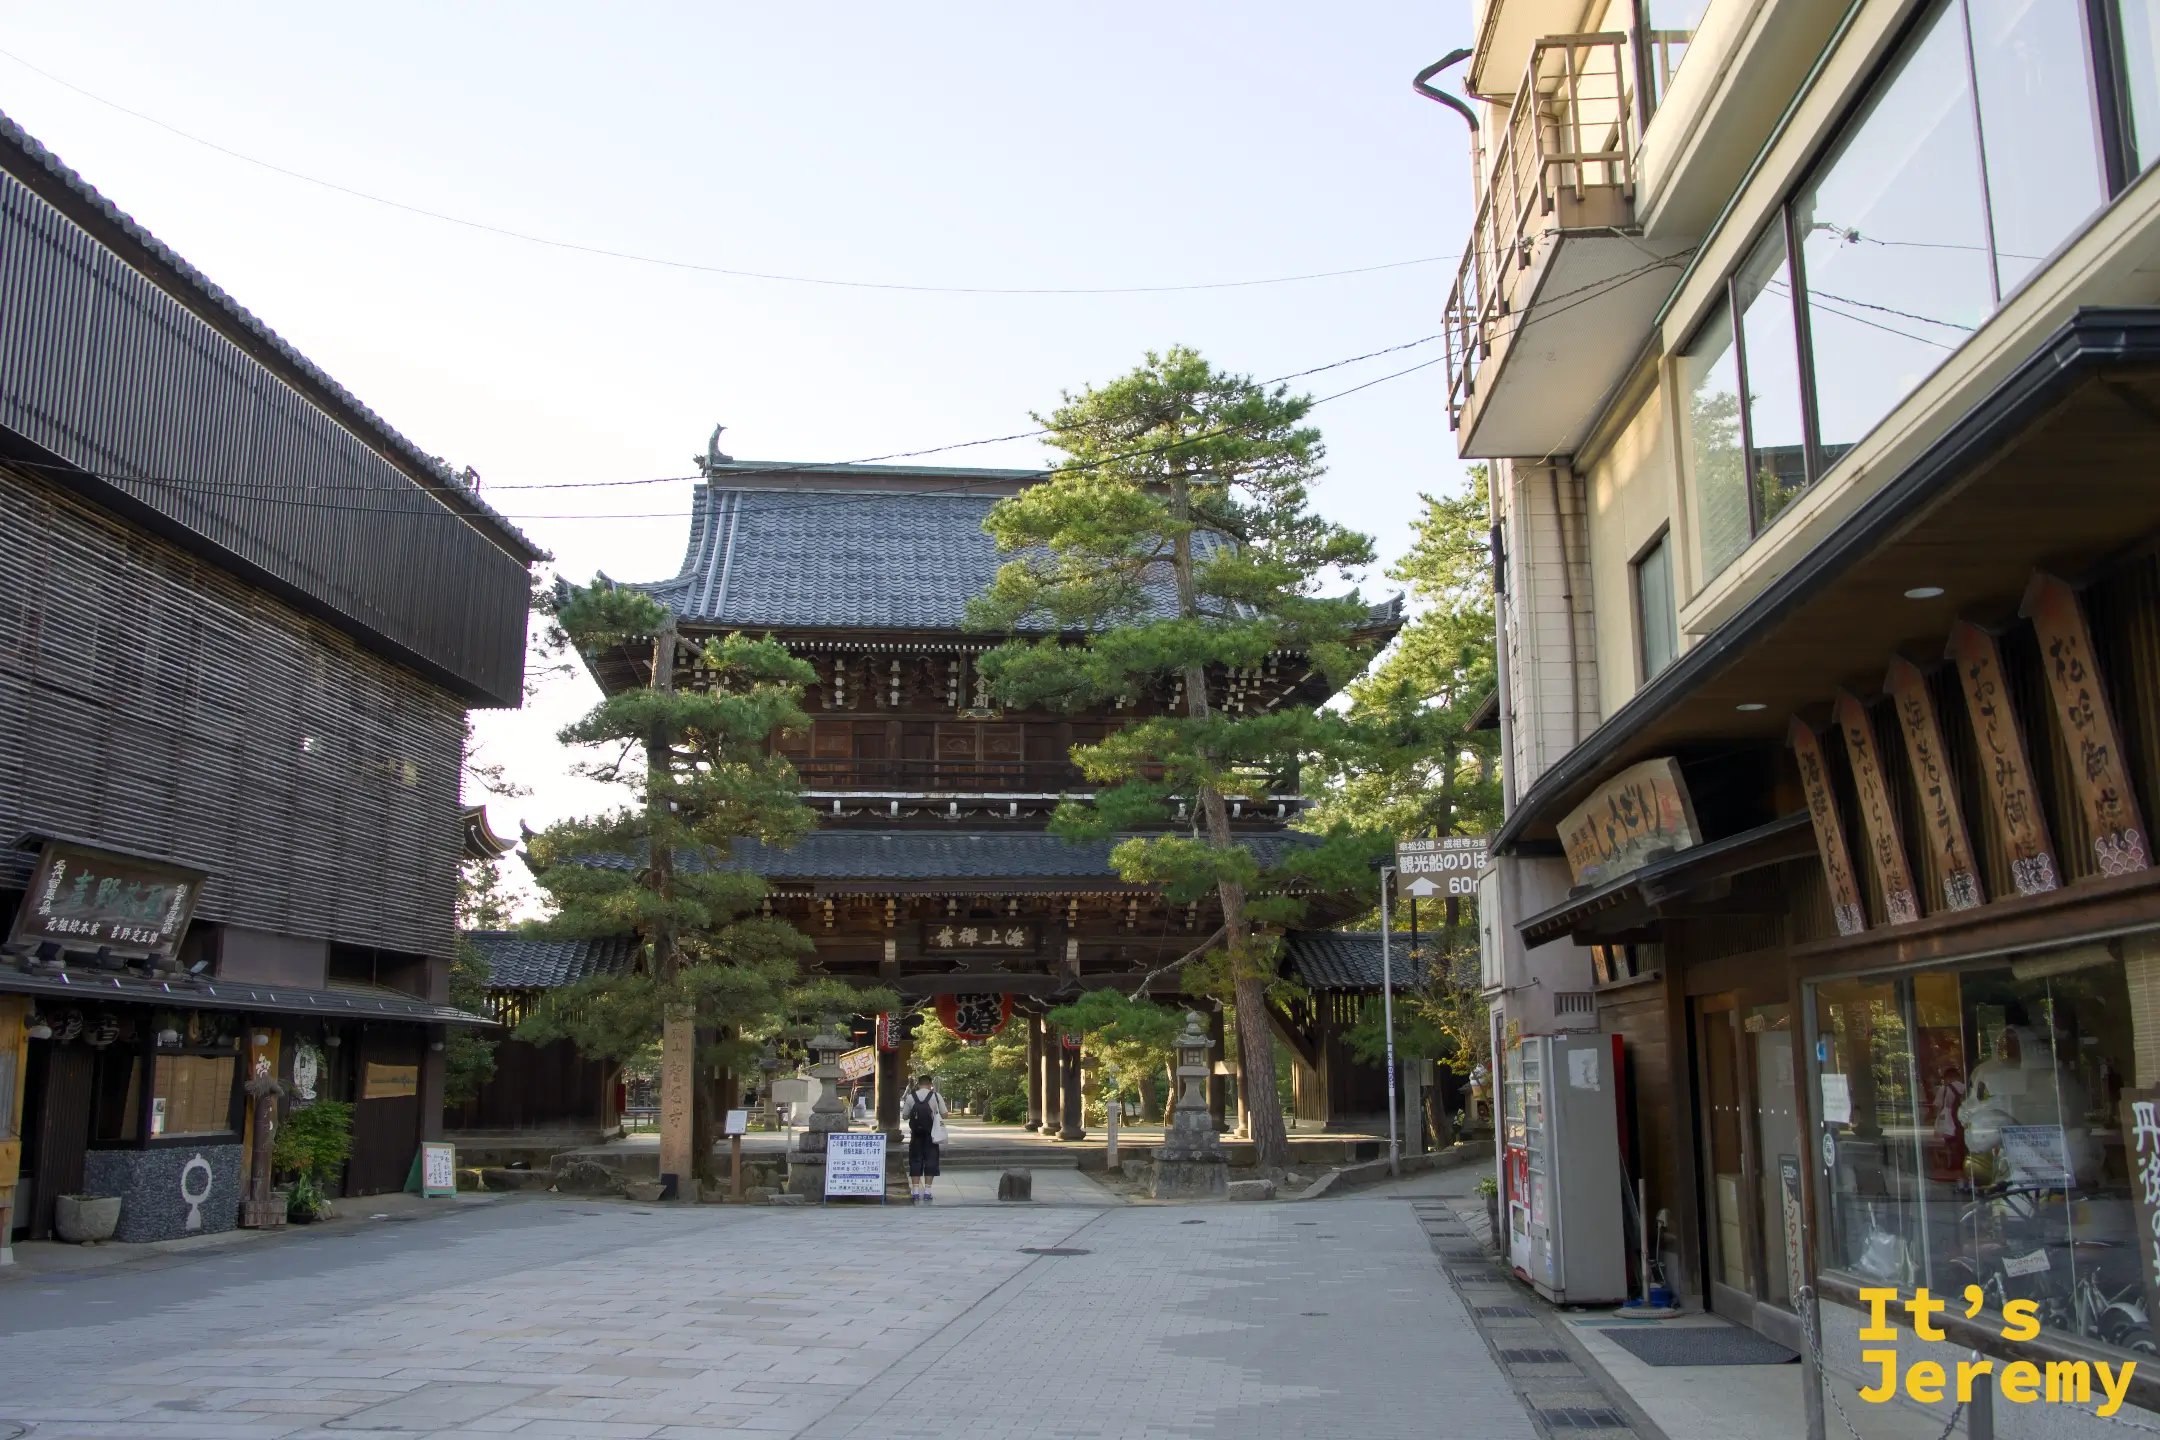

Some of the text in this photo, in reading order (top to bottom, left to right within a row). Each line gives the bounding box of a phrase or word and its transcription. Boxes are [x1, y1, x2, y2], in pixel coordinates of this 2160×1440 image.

[1399, 851, 1488, 874] 観光船のりば
